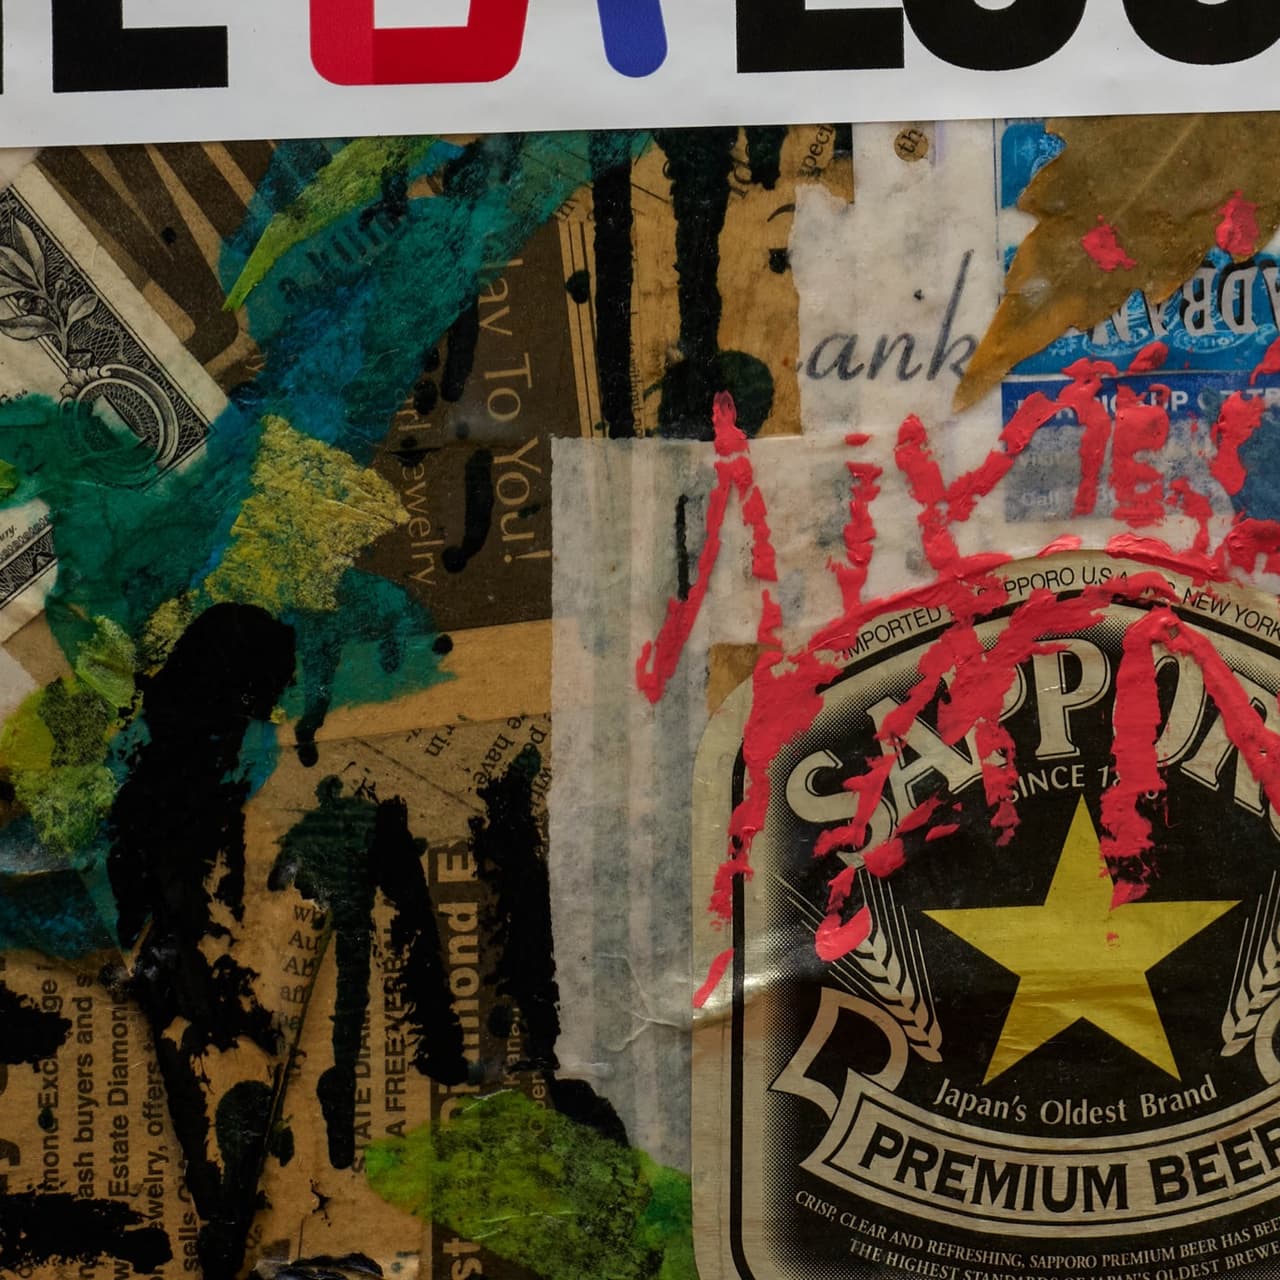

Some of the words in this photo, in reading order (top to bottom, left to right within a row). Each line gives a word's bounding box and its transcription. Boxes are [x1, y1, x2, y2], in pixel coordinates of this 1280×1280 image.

[485, 354, 534, 422] To
[500, 438, 552, 566] You!
[933, 1077, 1027, 1126] Japan's
[1039, 1096, 1130, 1127] Oldest
[1141, 1074, 1219, 1121] Brand
[856, 1121, 1131, 1216] PREMIUM
[839, 1212, 888, 1241] CLEAR
[925, 1238, 1027, 1271] REFRESHING,
[1029, 1253, 1099, 1271] SAPPORO
[1101, 1245, 1177, 1270] PREMIUM
